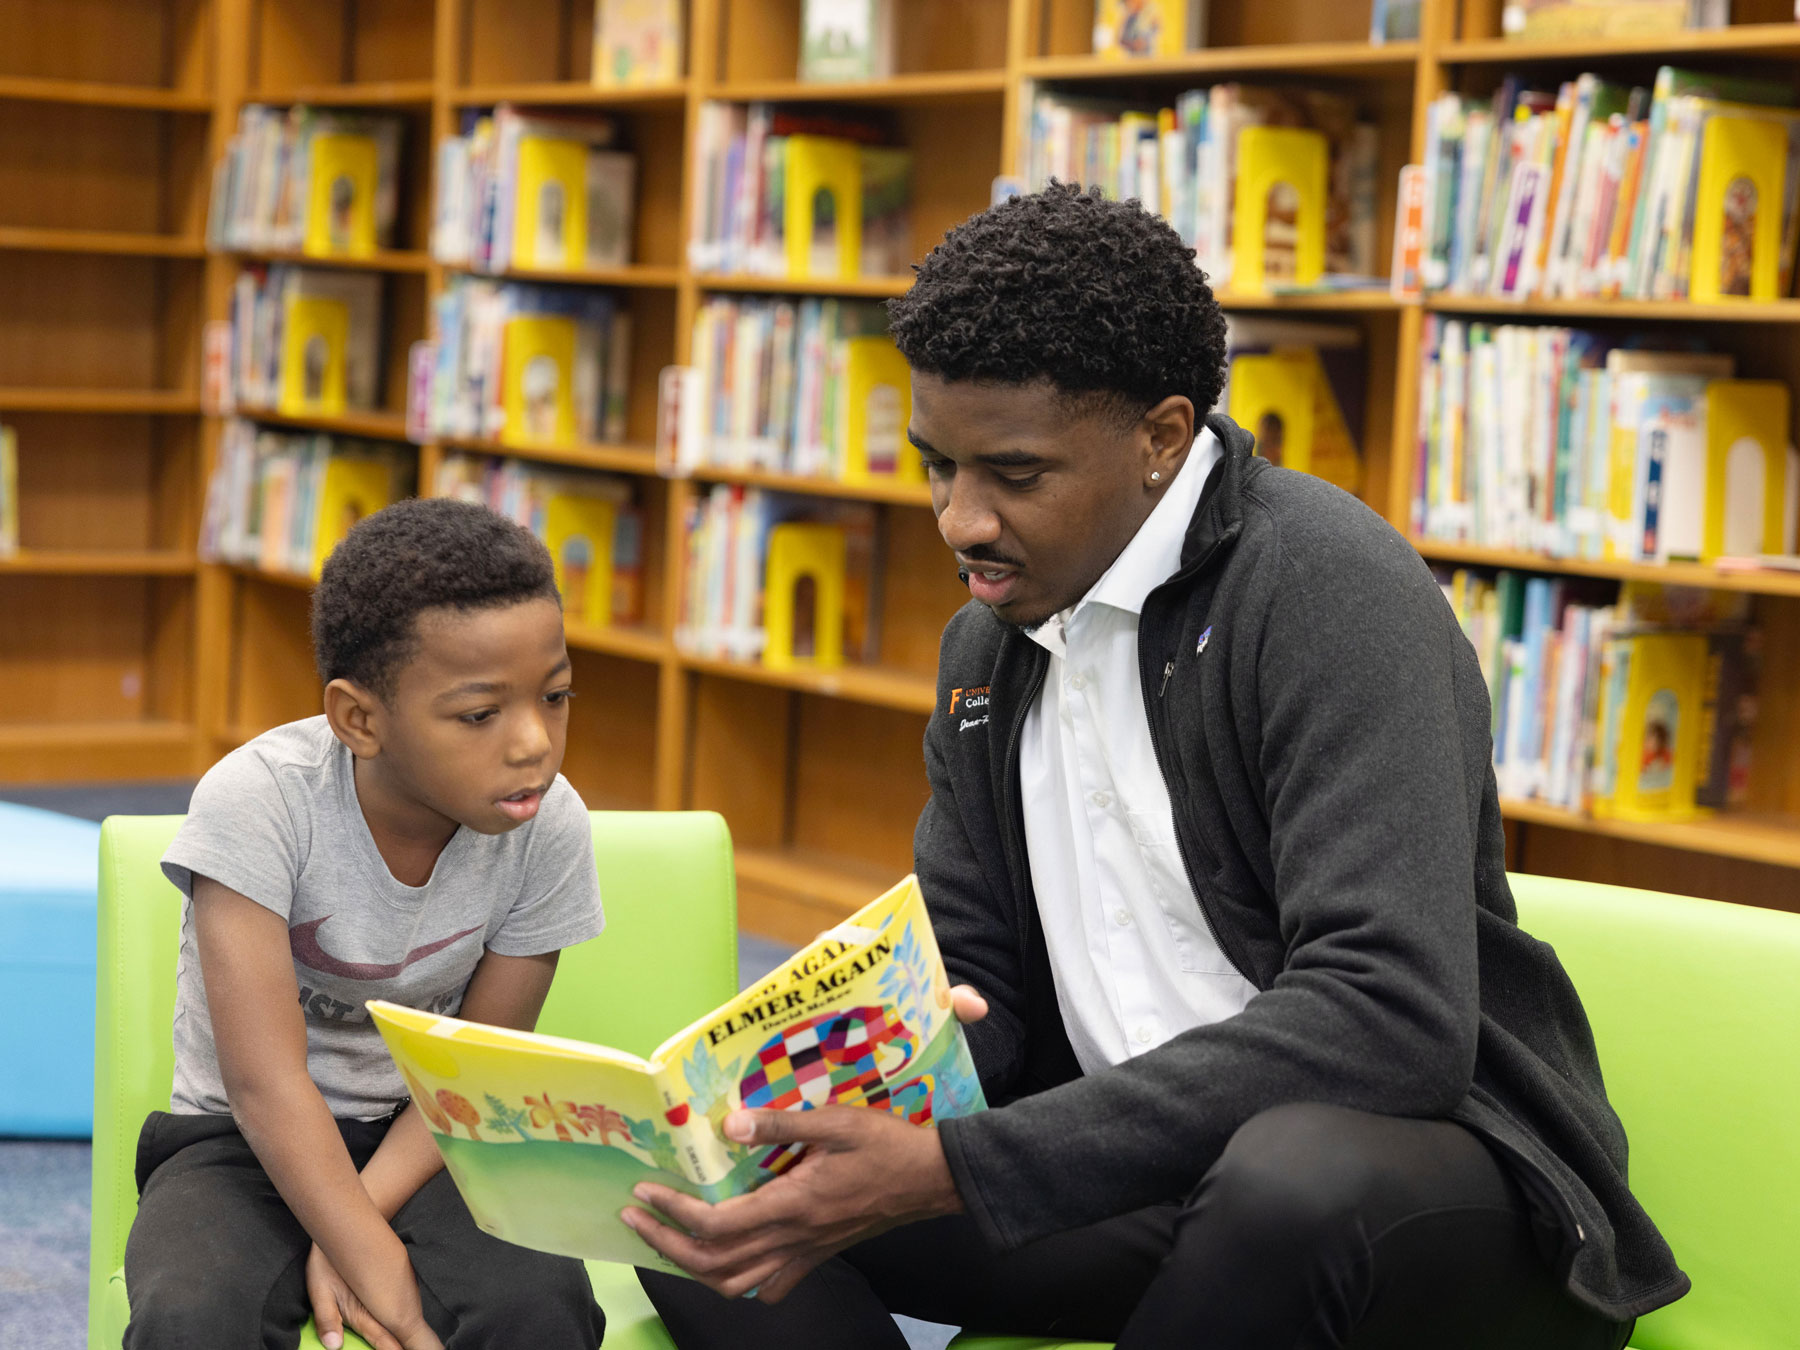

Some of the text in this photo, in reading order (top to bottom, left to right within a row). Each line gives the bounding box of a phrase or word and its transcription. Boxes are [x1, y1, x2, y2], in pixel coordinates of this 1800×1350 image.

[948, 687, 963, 715] F
[790, 938, 856, 985] AGAI
[707, 935, 892, 1047] ELMER AGAIN
[762, 1009, 803, 1032] David
[806, 988, 853, 1012] McKee
